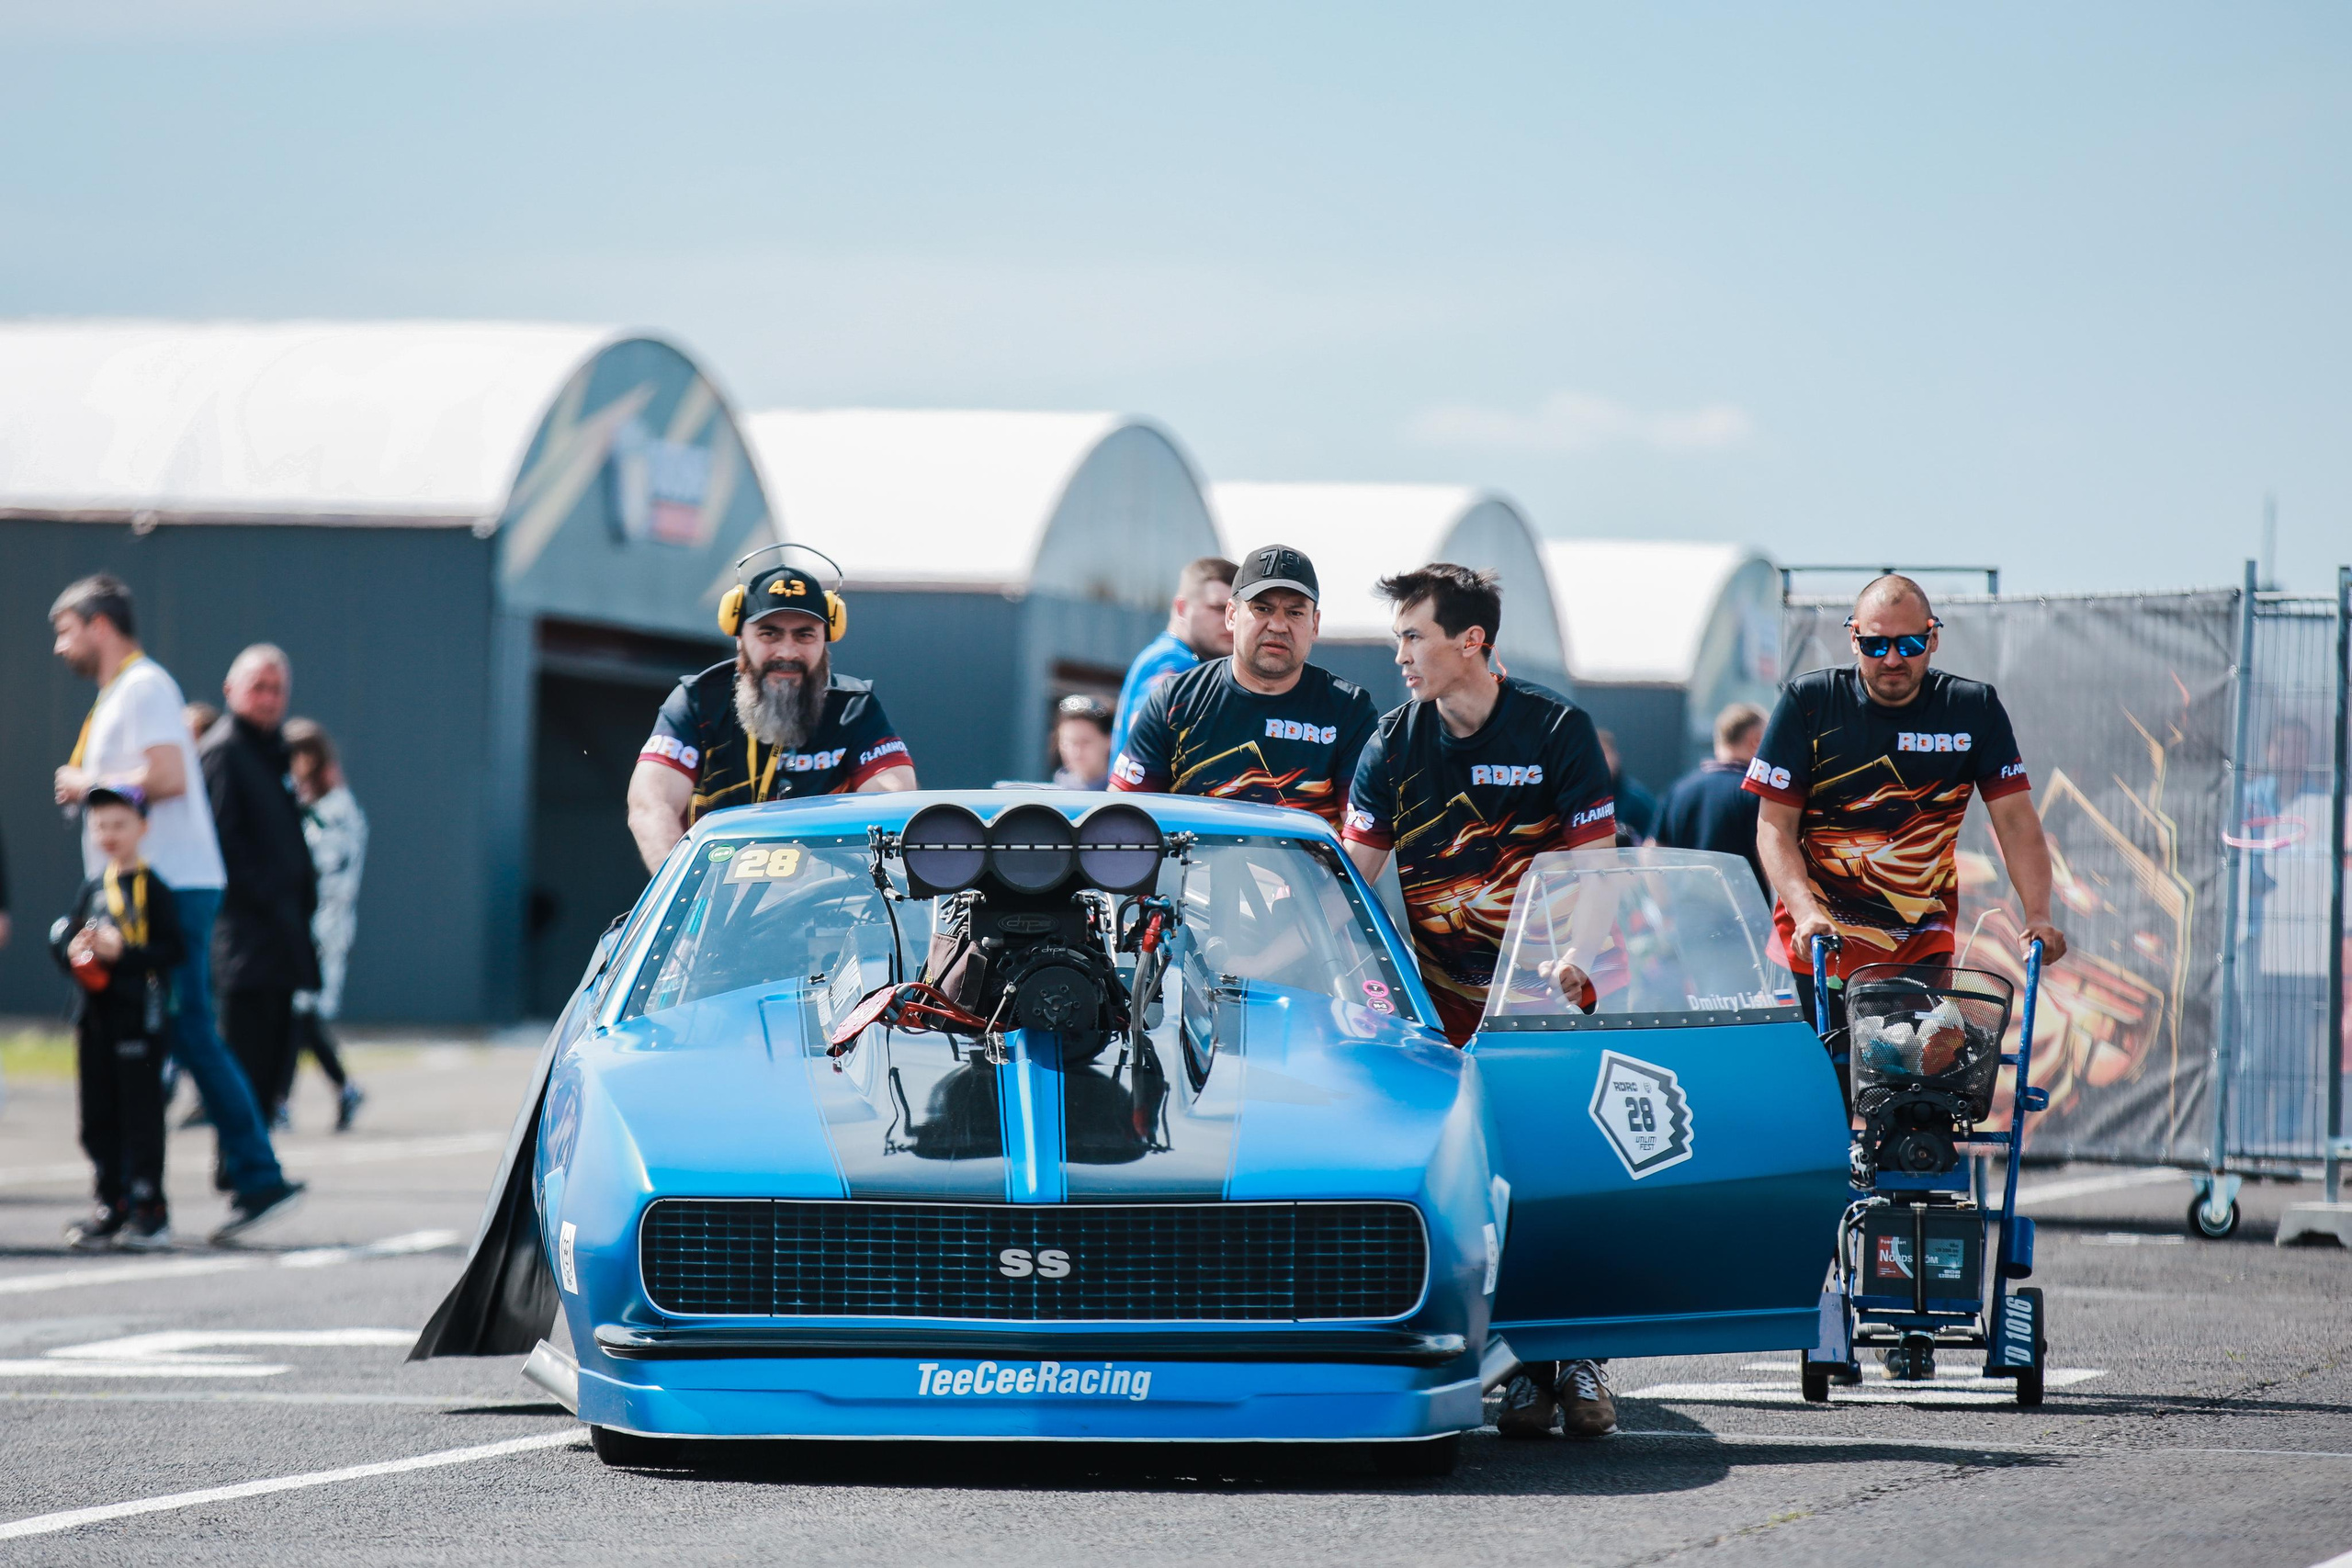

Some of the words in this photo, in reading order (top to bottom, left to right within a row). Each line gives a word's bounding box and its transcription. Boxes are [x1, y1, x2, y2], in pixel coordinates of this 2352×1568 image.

[1265, 718, 1337, 745] RDRC
[1898, 732, 1972, 752] RDRC
[1471, 764, 1544, 785] RDRC
[734, 848, 801, 878] 28
[1687, 994, 1739, 1013] Dmitry
[1625, 1096, 1657, 1133] 28
[999, 1248, 1071, 1279] SS
[2005, 1296, 2032, 1342] 1016
[918, 1360, 1152, 1402] TeeCeeRacing
